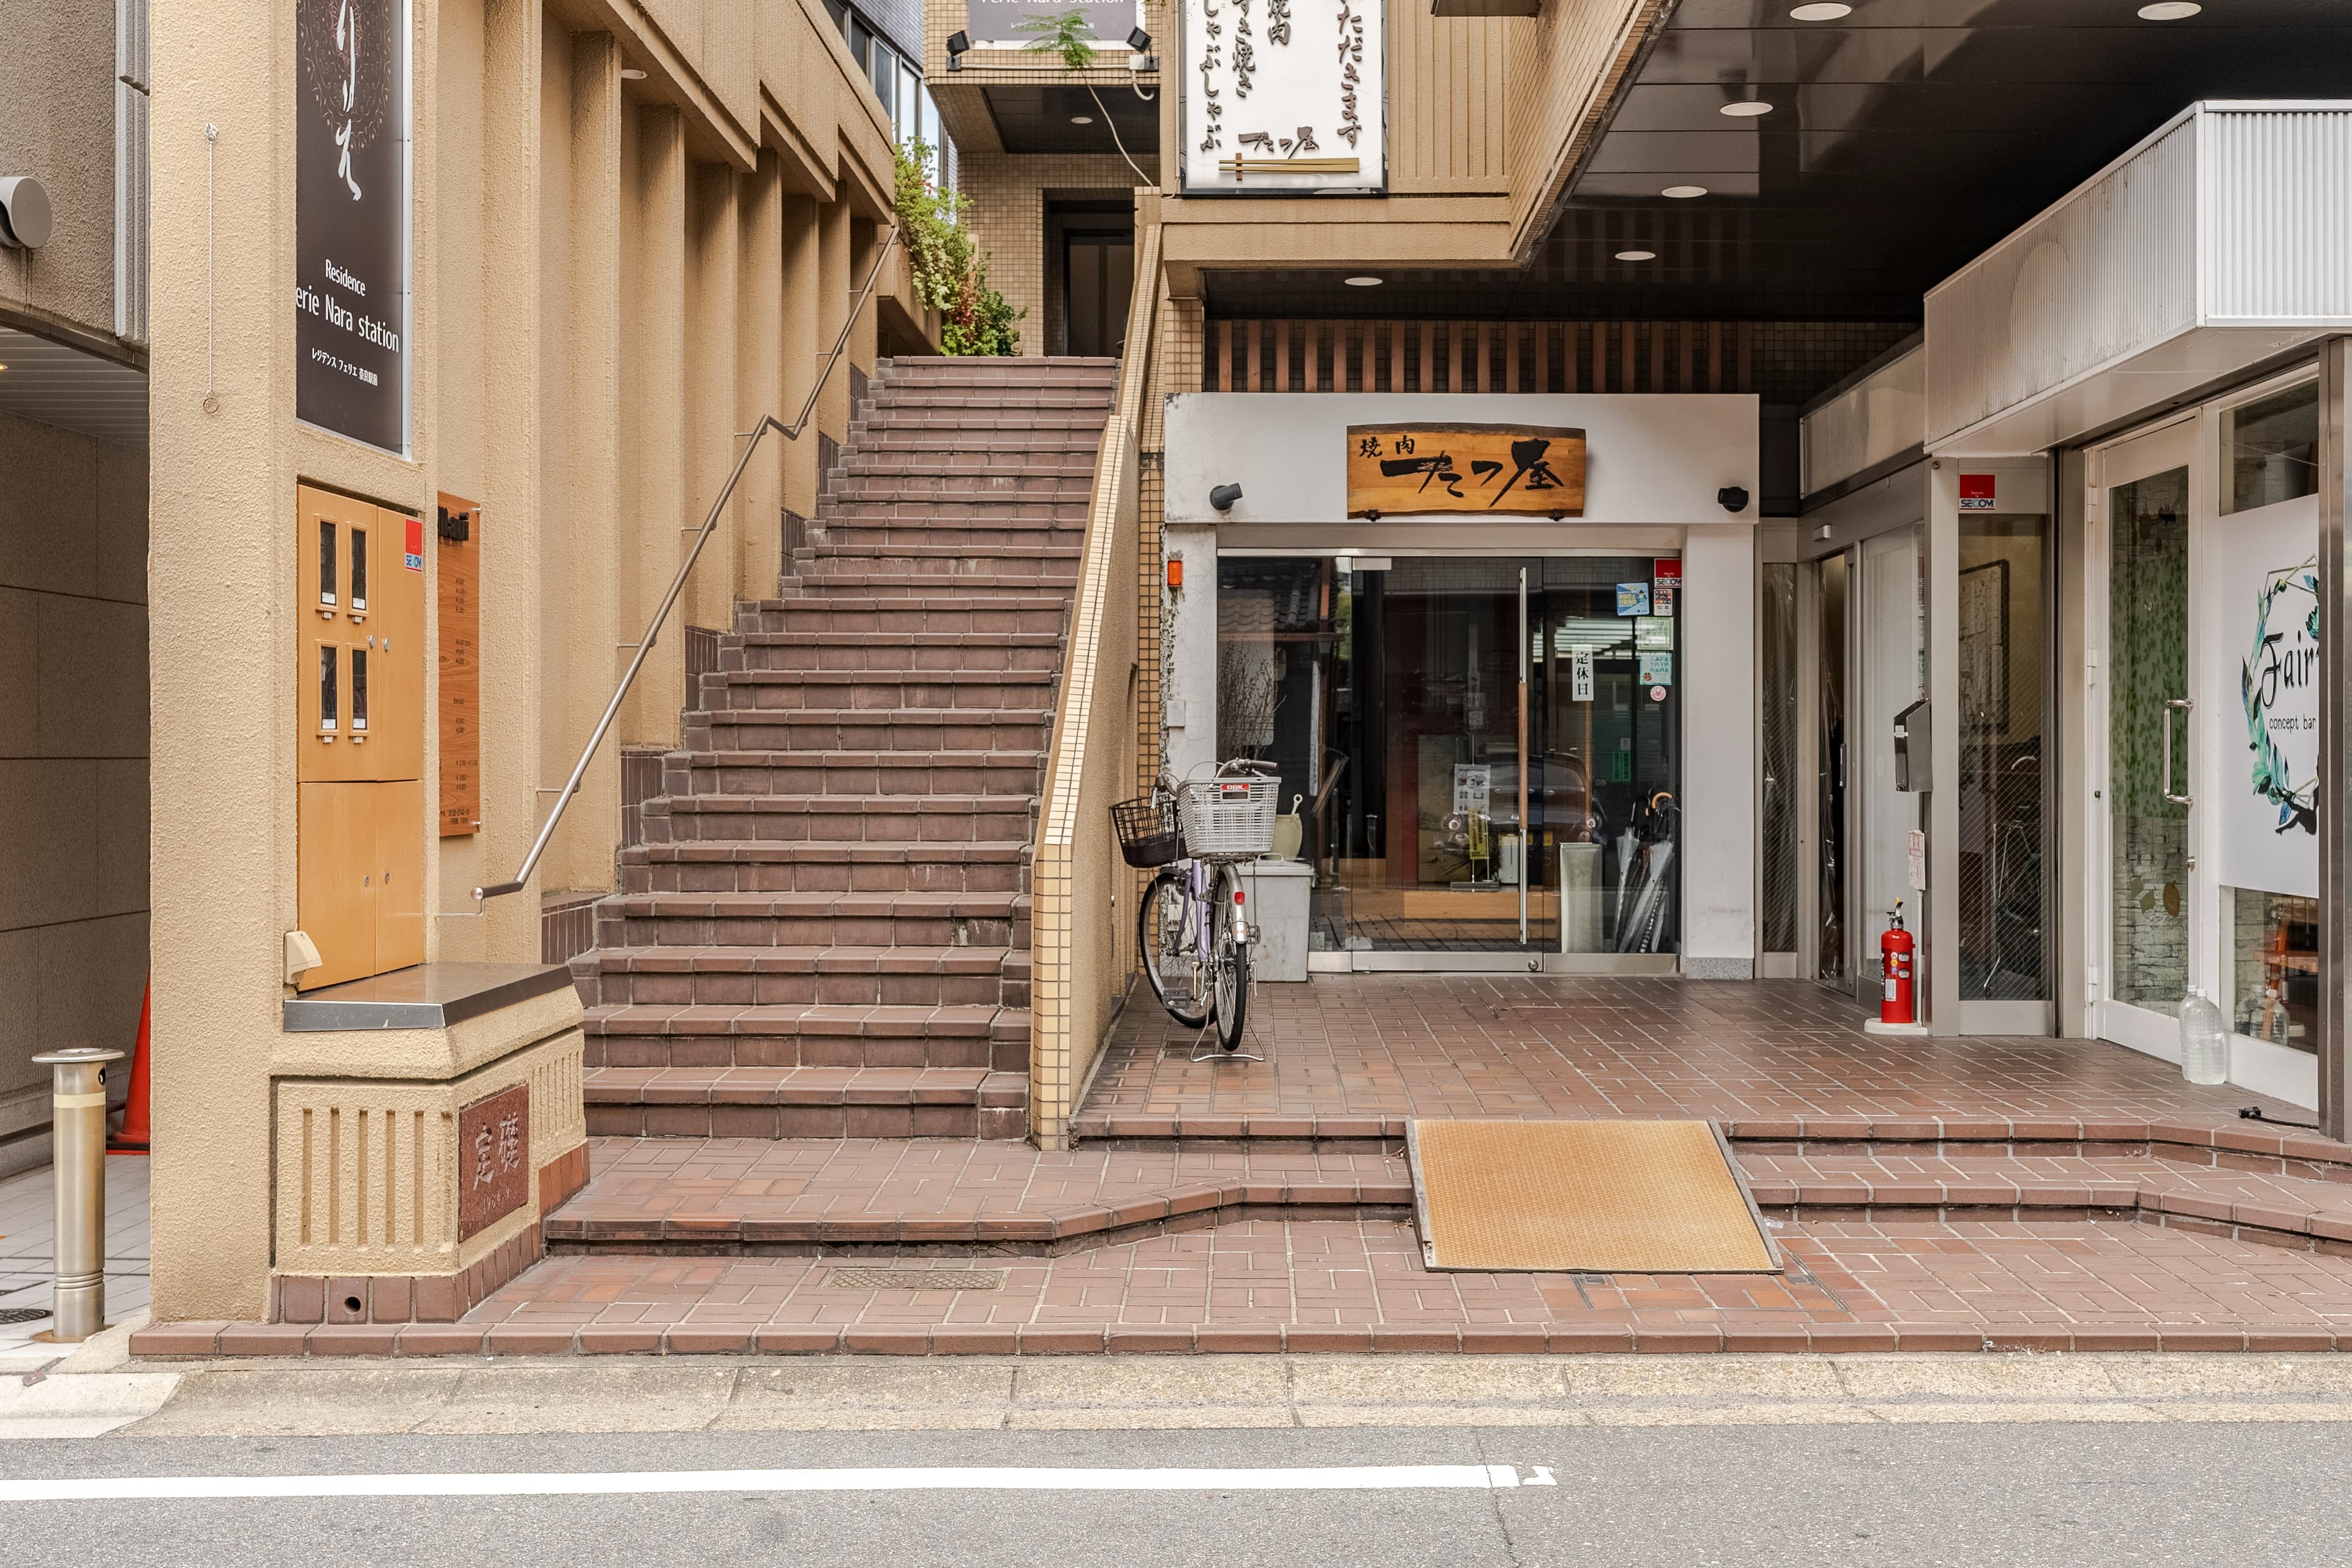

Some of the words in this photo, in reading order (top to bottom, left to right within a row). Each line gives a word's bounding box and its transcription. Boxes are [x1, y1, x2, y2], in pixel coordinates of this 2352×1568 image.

[1268, 0, 1291, 46] 焼肉
[1200, 0, 1222, 152] しゃぶしゃぶ
[1337, 0, 1363, 149] ただきます
[325, 258, 366, 296] Residence
[325, 293, 353, 332] Nara
[358, 315, 399, 353] station
[312, 347, 337, 368] レジデンス
[338, 360, 358, 377] フェリエ
[359, 368, 378, 386] 奈良駅前
[1359, 435, 1415, 459] 焼肉
[1961, 499, 1994, 508] SECOM
[406, 554, 422, 568] SECOM
[1576, 651, 1589, 696] 定休日
[2261, 630, 2320, 709] Fair
[2269, 715, 2299, 734] concept
[2303, 713, 2317, 730] bar
